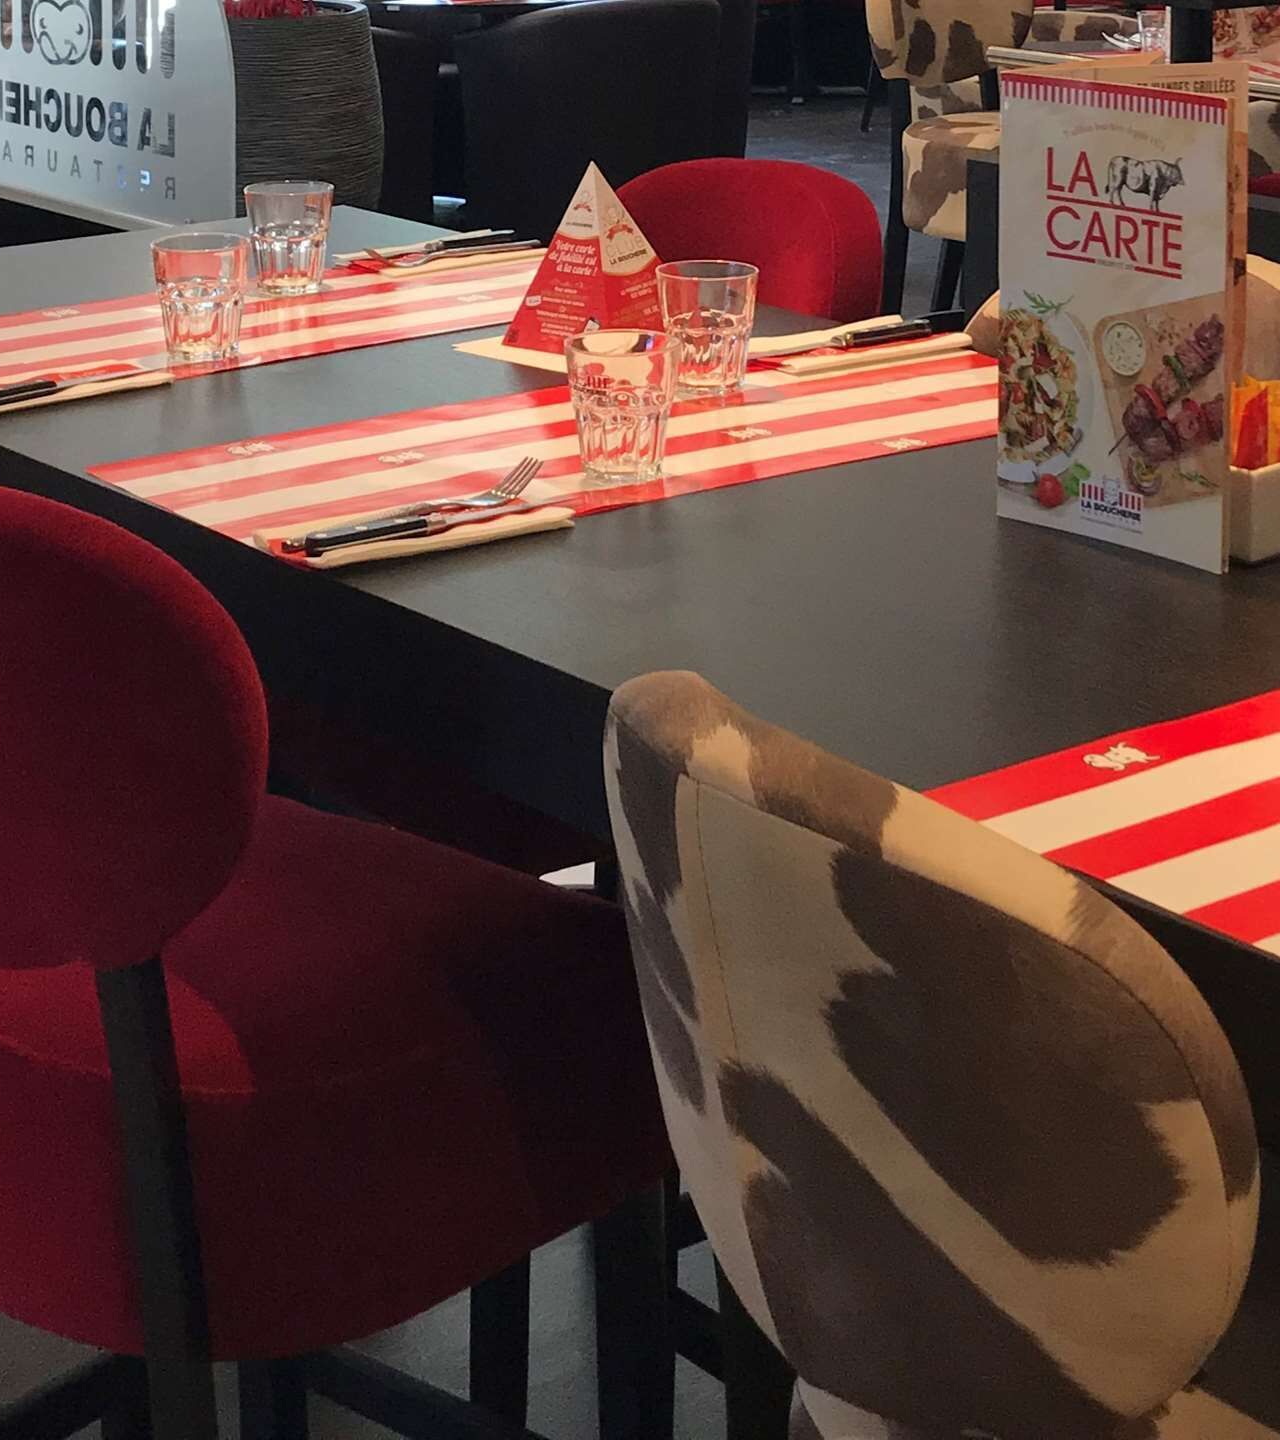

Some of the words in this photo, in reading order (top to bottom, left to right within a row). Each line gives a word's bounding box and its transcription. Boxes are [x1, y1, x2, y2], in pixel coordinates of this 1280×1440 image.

[1046, 146, 1098, 197] LA
[1045, 205, 1183, 271] CARTE
[1081, 500, 1092, 509] LA
[1094, 502, 1142, 522] BOUCHERIE
